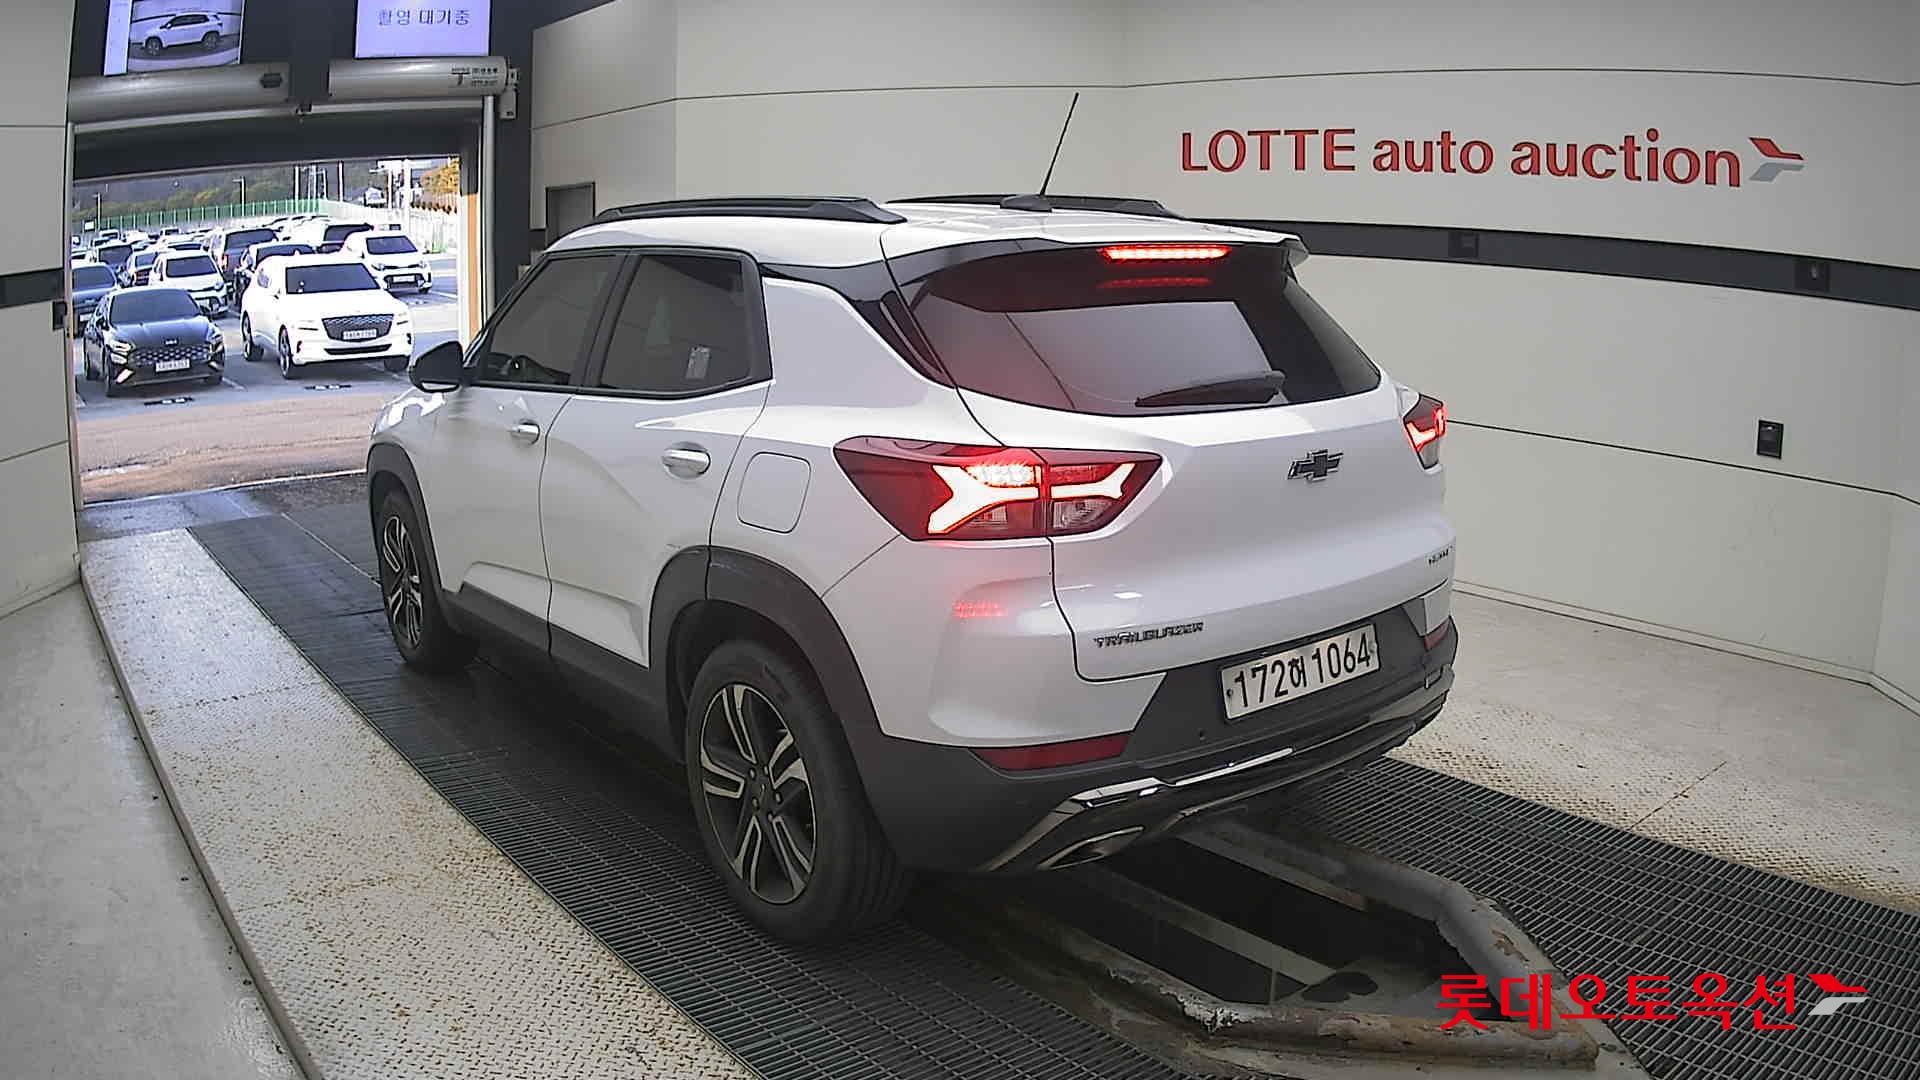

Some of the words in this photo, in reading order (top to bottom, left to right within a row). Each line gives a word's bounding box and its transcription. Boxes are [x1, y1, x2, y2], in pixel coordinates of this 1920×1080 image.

[419, 8, 471, 25] 대기중
[1181, 128, 1357, 172] LOTTE
[1372, 131, 1494, 173] auto
[1510, 128, 1742, 187] auction
[1311, 632, 1371, 683] 1064
